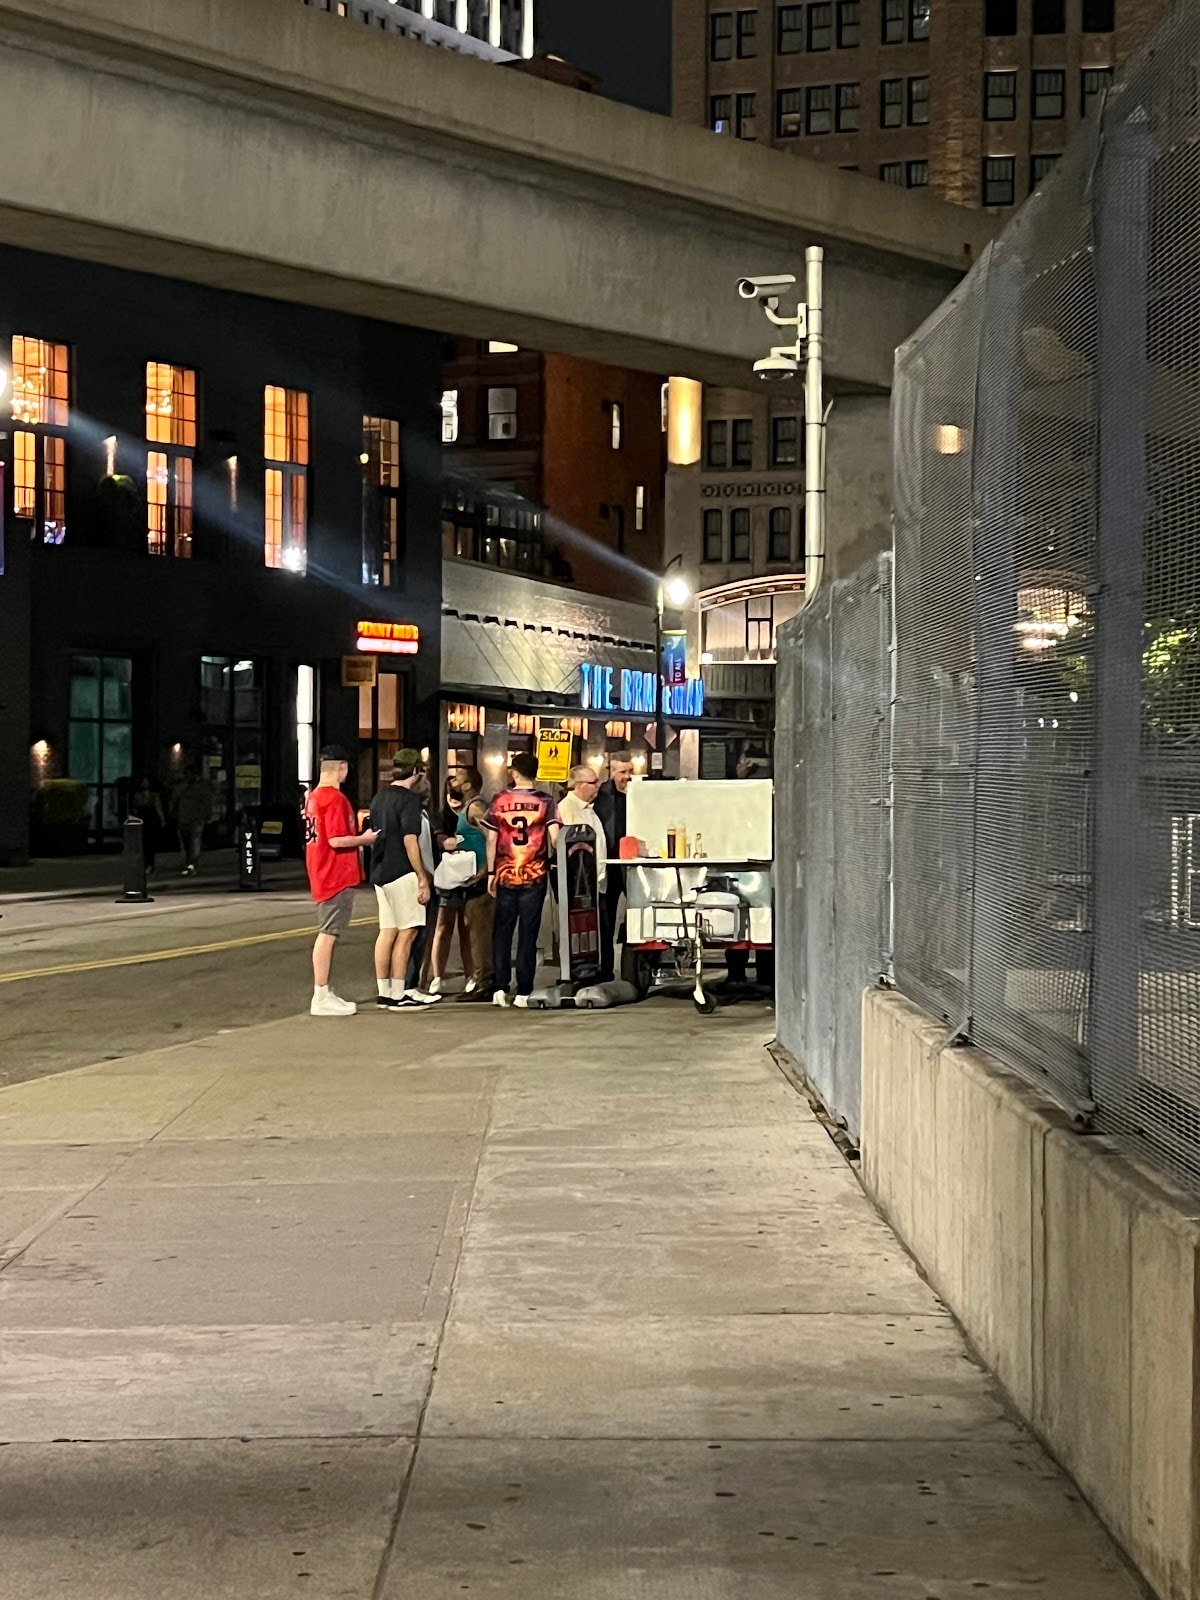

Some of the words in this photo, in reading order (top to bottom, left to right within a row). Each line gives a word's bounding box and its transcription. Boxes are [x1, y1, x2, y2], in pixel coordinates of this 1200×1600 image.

[581, 663, 614, 710] THE
[542, 730, 568, 741] SLOW
[512, 816, 528, 846] 3
[245, 832, 254, 874] VALET
